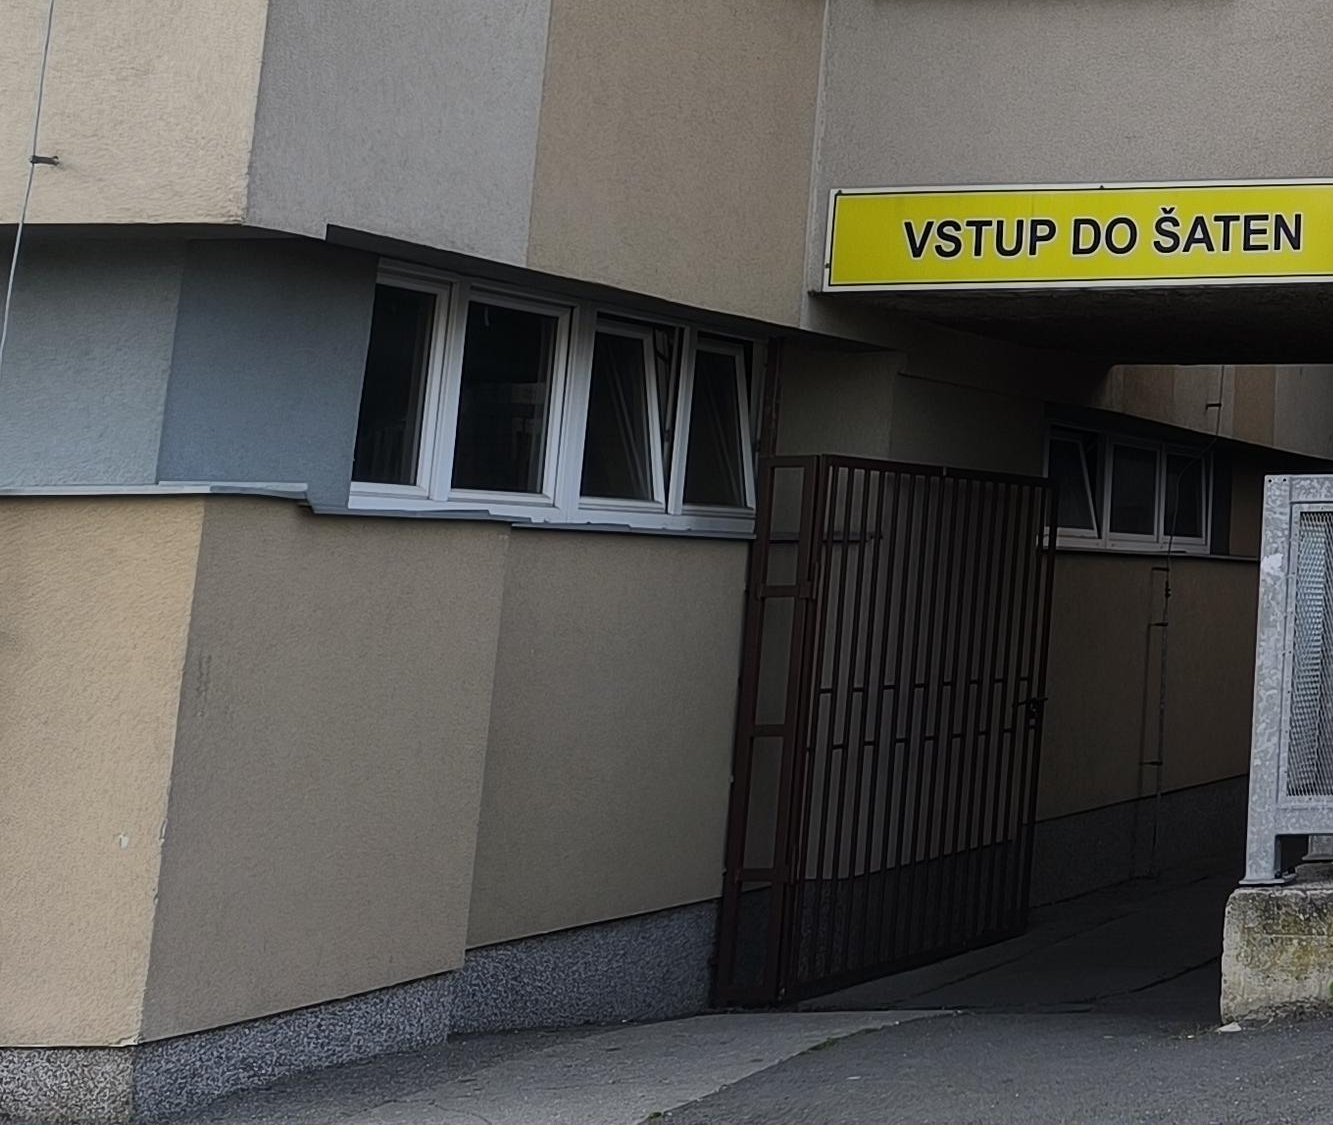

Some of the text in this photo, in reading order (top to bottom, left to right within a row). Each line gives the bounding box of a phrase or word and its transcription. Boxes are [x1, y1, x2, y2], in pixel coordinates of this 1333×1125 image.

[903, 207, 1303, 259] VSTUP DO ŠATEN
